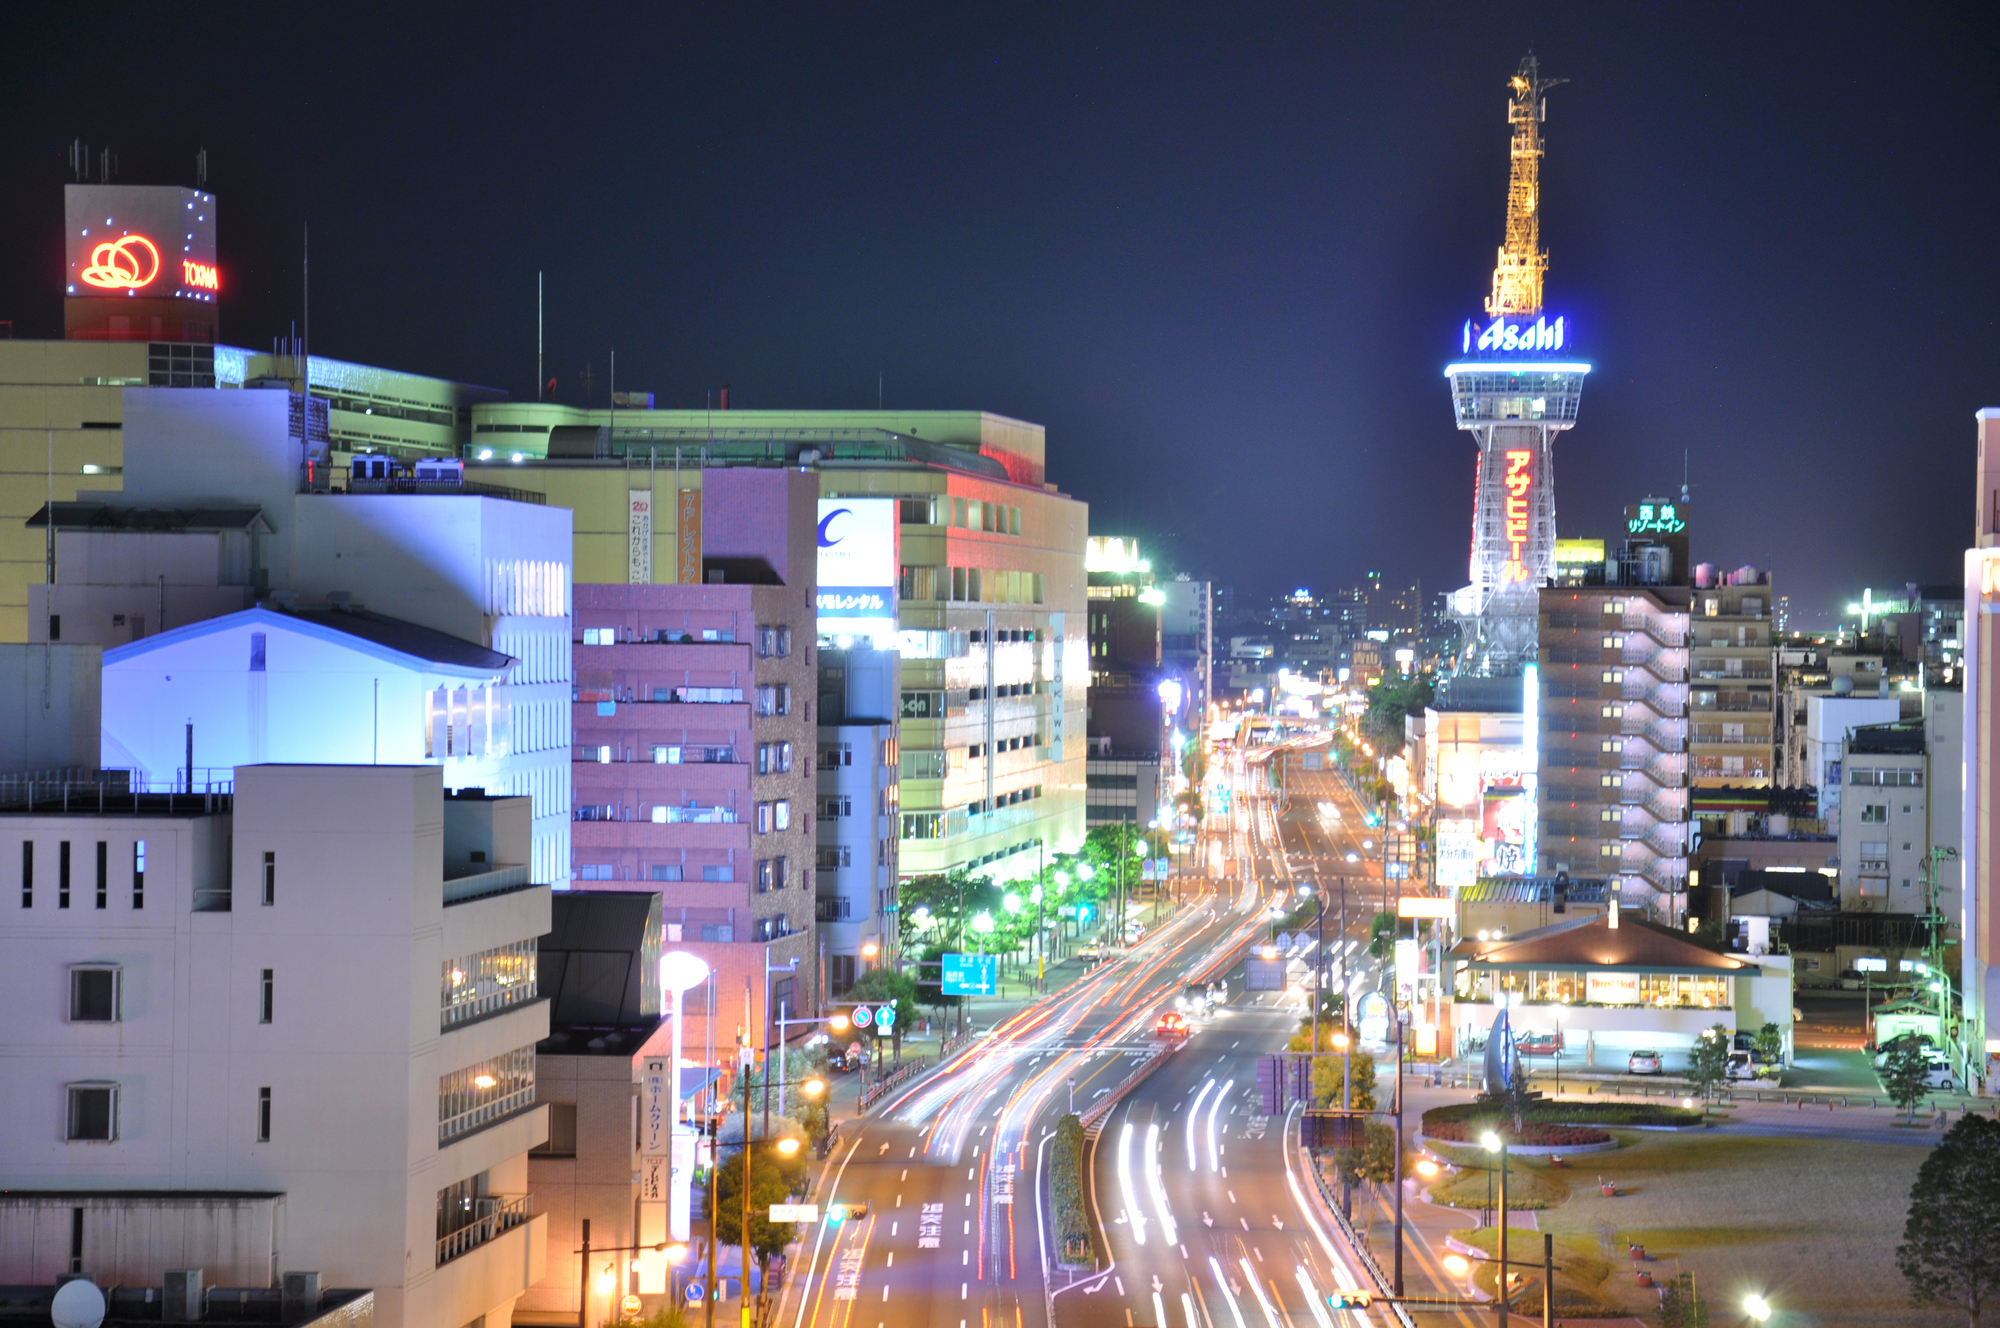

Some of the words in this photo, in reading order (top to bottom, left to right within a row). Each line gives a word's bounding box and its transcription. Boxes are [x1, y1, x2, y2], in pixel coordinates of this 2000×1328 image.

[182, 260, 218, 291] TOKIWA
[1477, 315, 1564, 351] Asahi
[684, 494, 696, 521] 7F
[1505, 450, 1531, 582] アサヒビール
[682, 526, 696, 584] レストラ
[1054, 660, 1062, 742] TOKIWA
